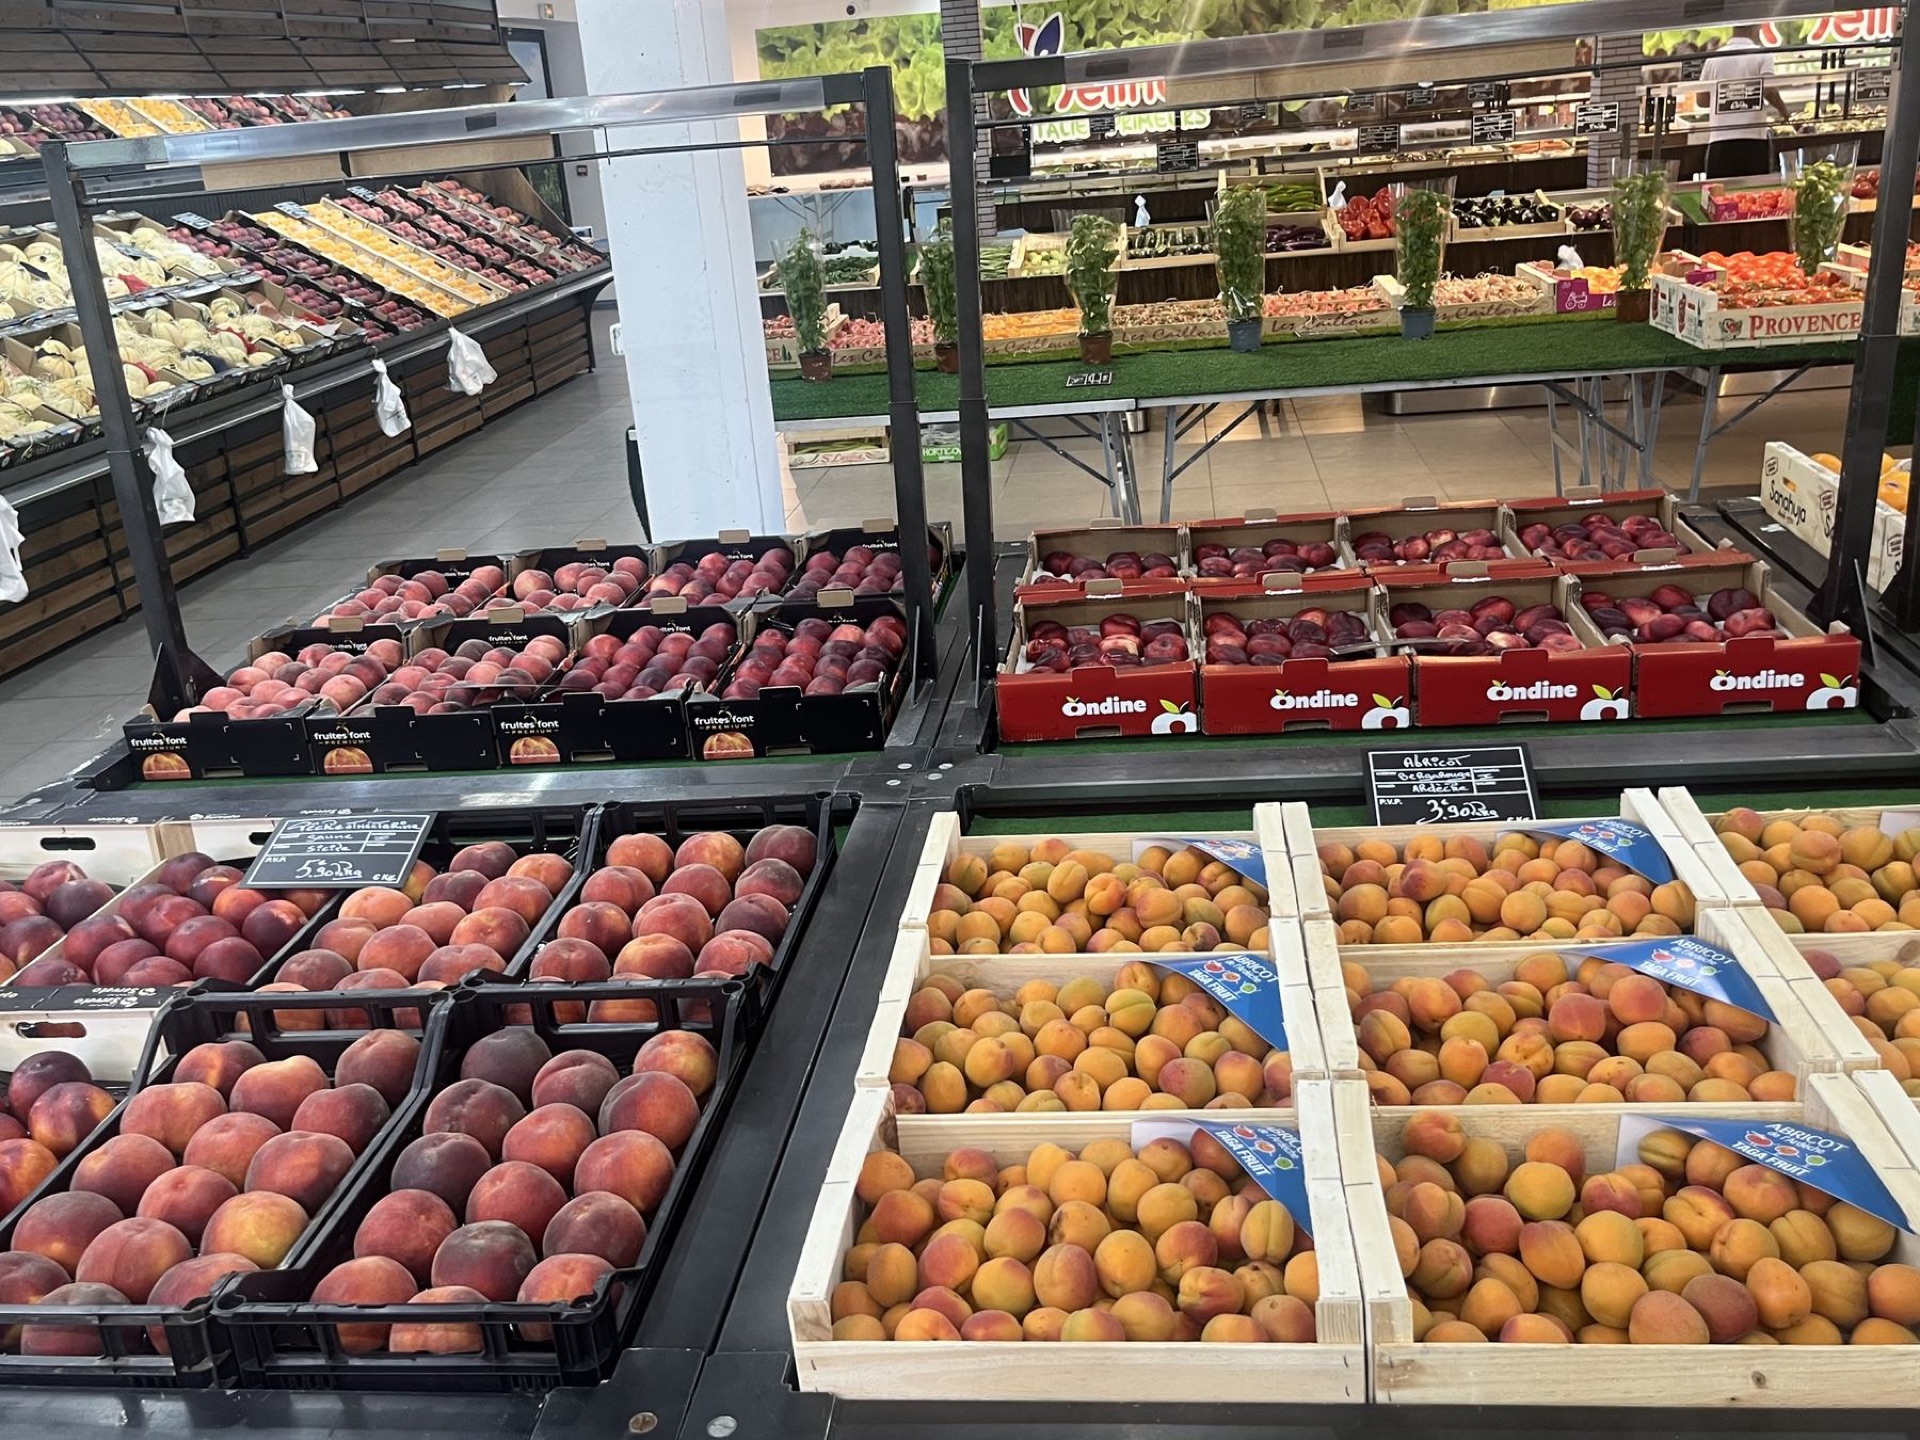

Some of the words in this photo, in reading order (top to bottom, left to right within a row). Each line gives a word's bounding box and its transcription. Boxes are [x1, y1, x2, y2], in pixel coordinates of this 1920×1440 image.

[1122, 326, 1146, 343] Les
[1271, 318, 1295, 333] Les
[1749, 313, 1862, 339] PROVENCE
[1769, 480, 1807, 526] Sanahuja
[1486, 680, 1577, 701] Ondine
[1709, 670, 1804, 691] Ondine
[1062, 696, 1147, 717] Ondine
[1270, 689, 1359, 710] Ondine
[537, 720, 560, 729] font
[732, 714, 755, 724] font
[165, 736, 188, 746] font
[349, 731, 372, 740] font
[1670, 939, 1737, 964] ABRICOT
[1665, 971, 1701, 987] FRUIT
[1211, 981, 1238, 1002] FRUIT
[1765, 1123, 1849, 1152] ABRICOT
[1237, 1149, 1271, 1175] FRUIT
[1732, 1141, 1767, 1159] TAGA
[1768, 1156, 1811, 1176] FRUIT
